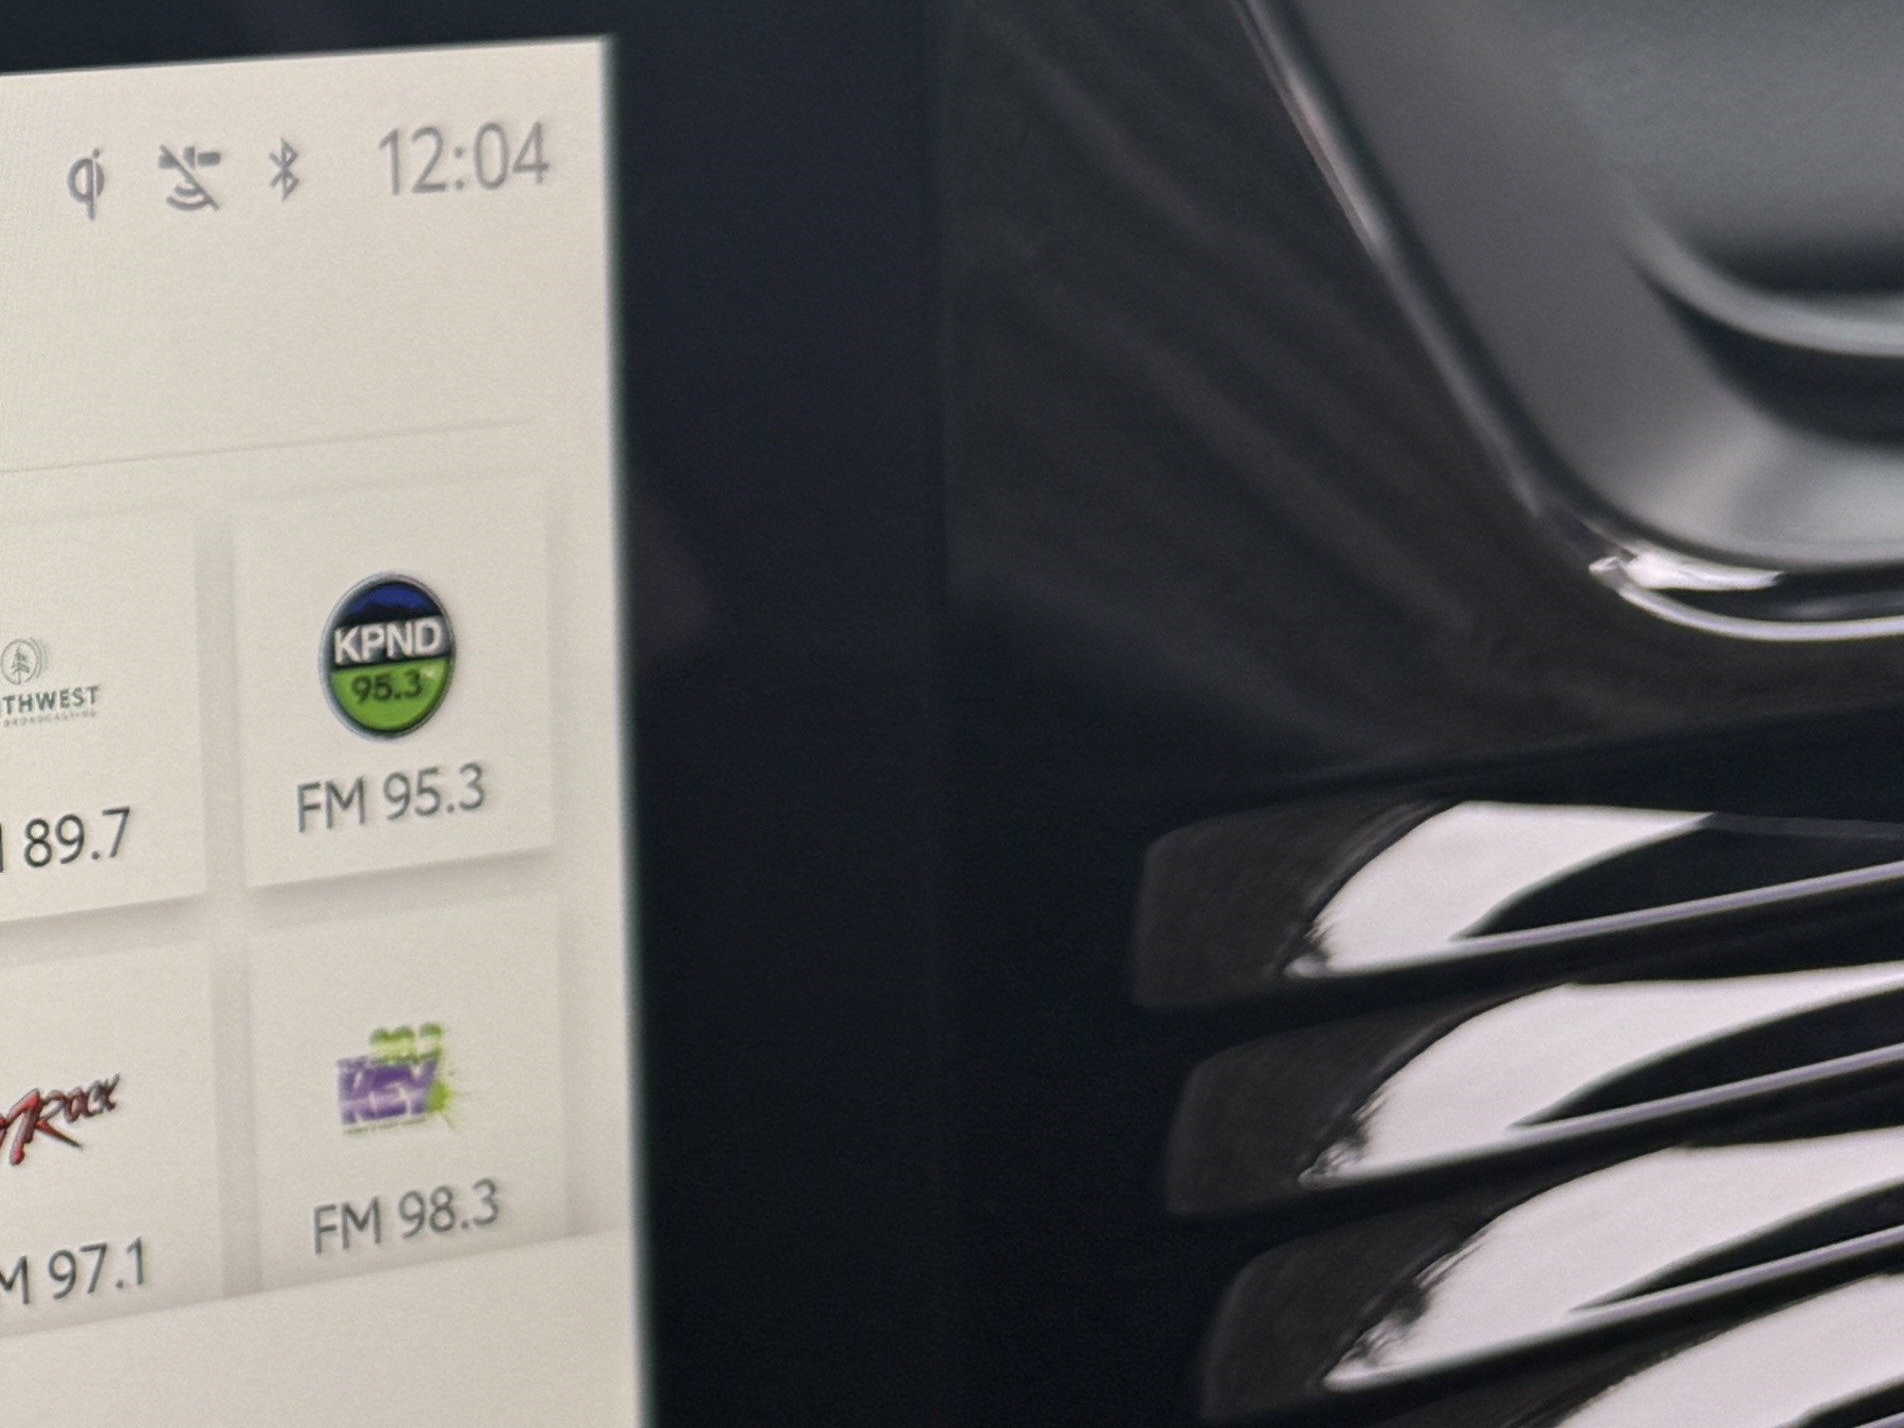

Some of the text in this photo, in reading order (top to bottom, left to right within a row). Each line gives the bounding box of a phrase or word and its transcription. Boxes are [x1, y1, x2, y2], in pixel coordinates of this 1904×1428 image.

[380, 120, 553, 195] 12:04
[334, 618, 444, 666] KPND
[351, 669, 424, 704] 95.3
[298, 761, 489, 832] FM 95.3
[24, 805, 133, 869] 89.7
[315, 1178, 503, 1254] FM 98.3
[48, 1238, 149, 1301] 97.1
